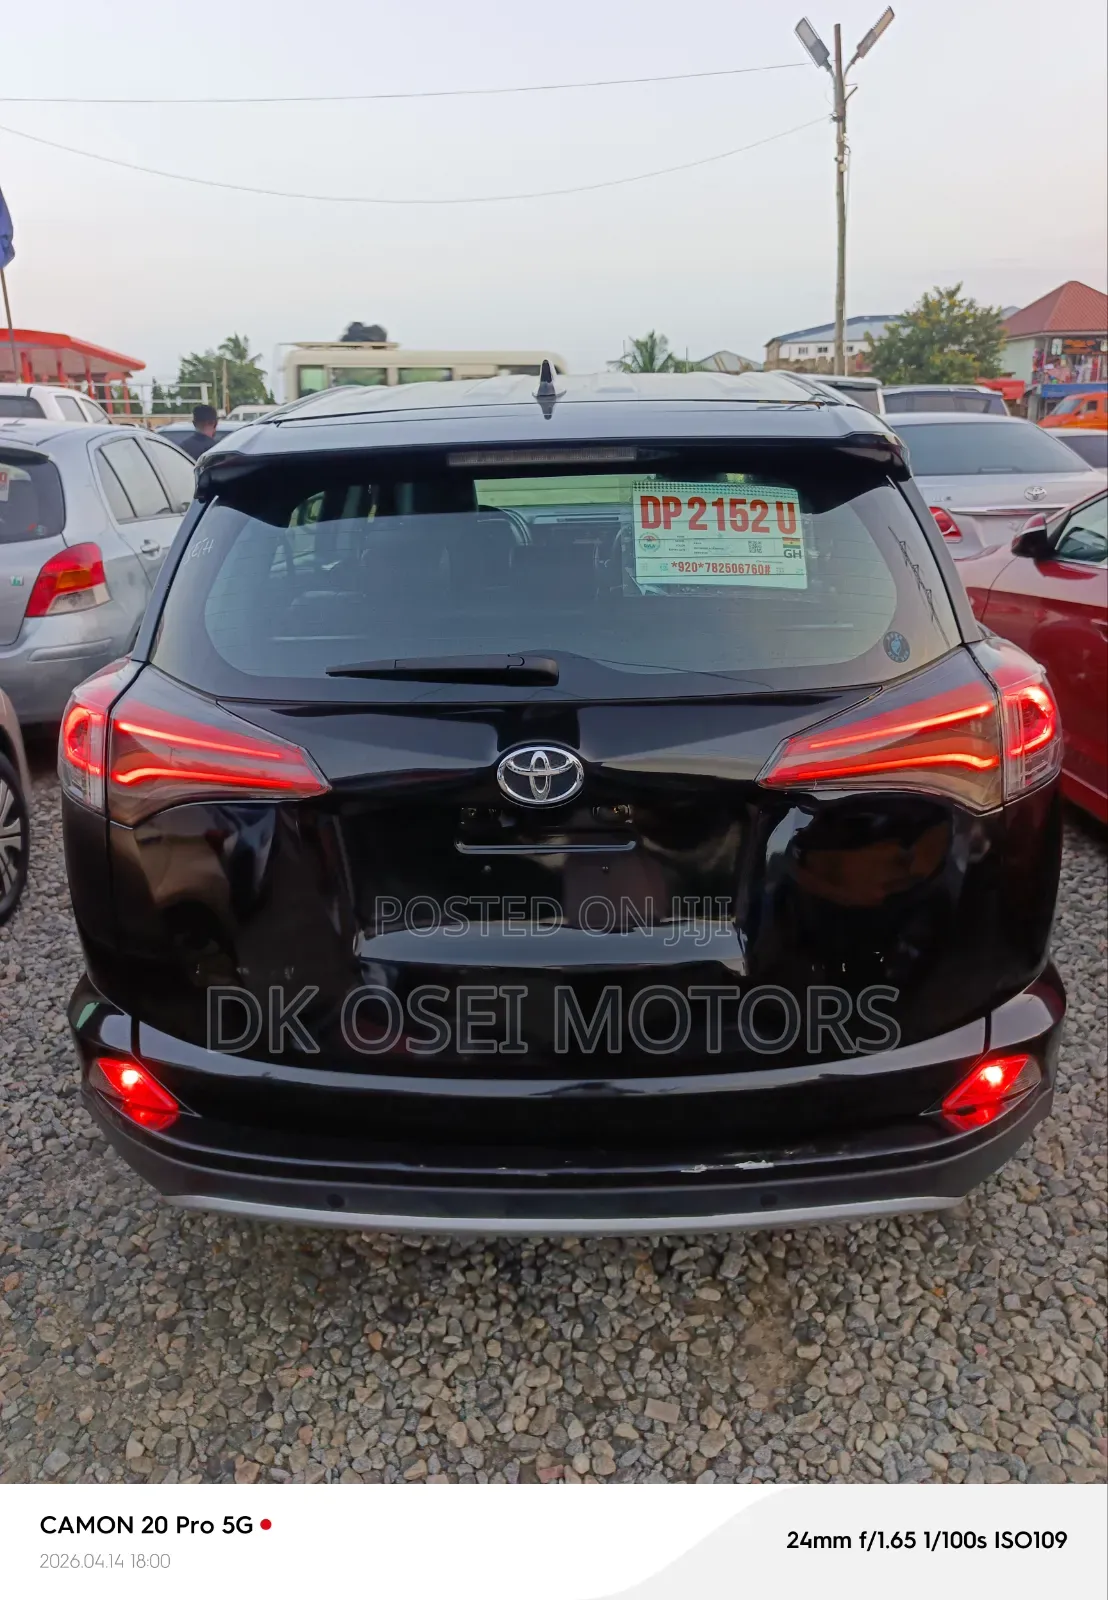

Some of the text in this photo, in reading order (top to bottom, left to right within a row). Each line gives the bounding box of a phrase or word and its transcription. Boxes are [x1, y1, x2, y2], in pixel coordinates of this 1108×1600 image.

[640, 495, 797, 535] DP 2152 U
[783, 549, 802, 559] GH
